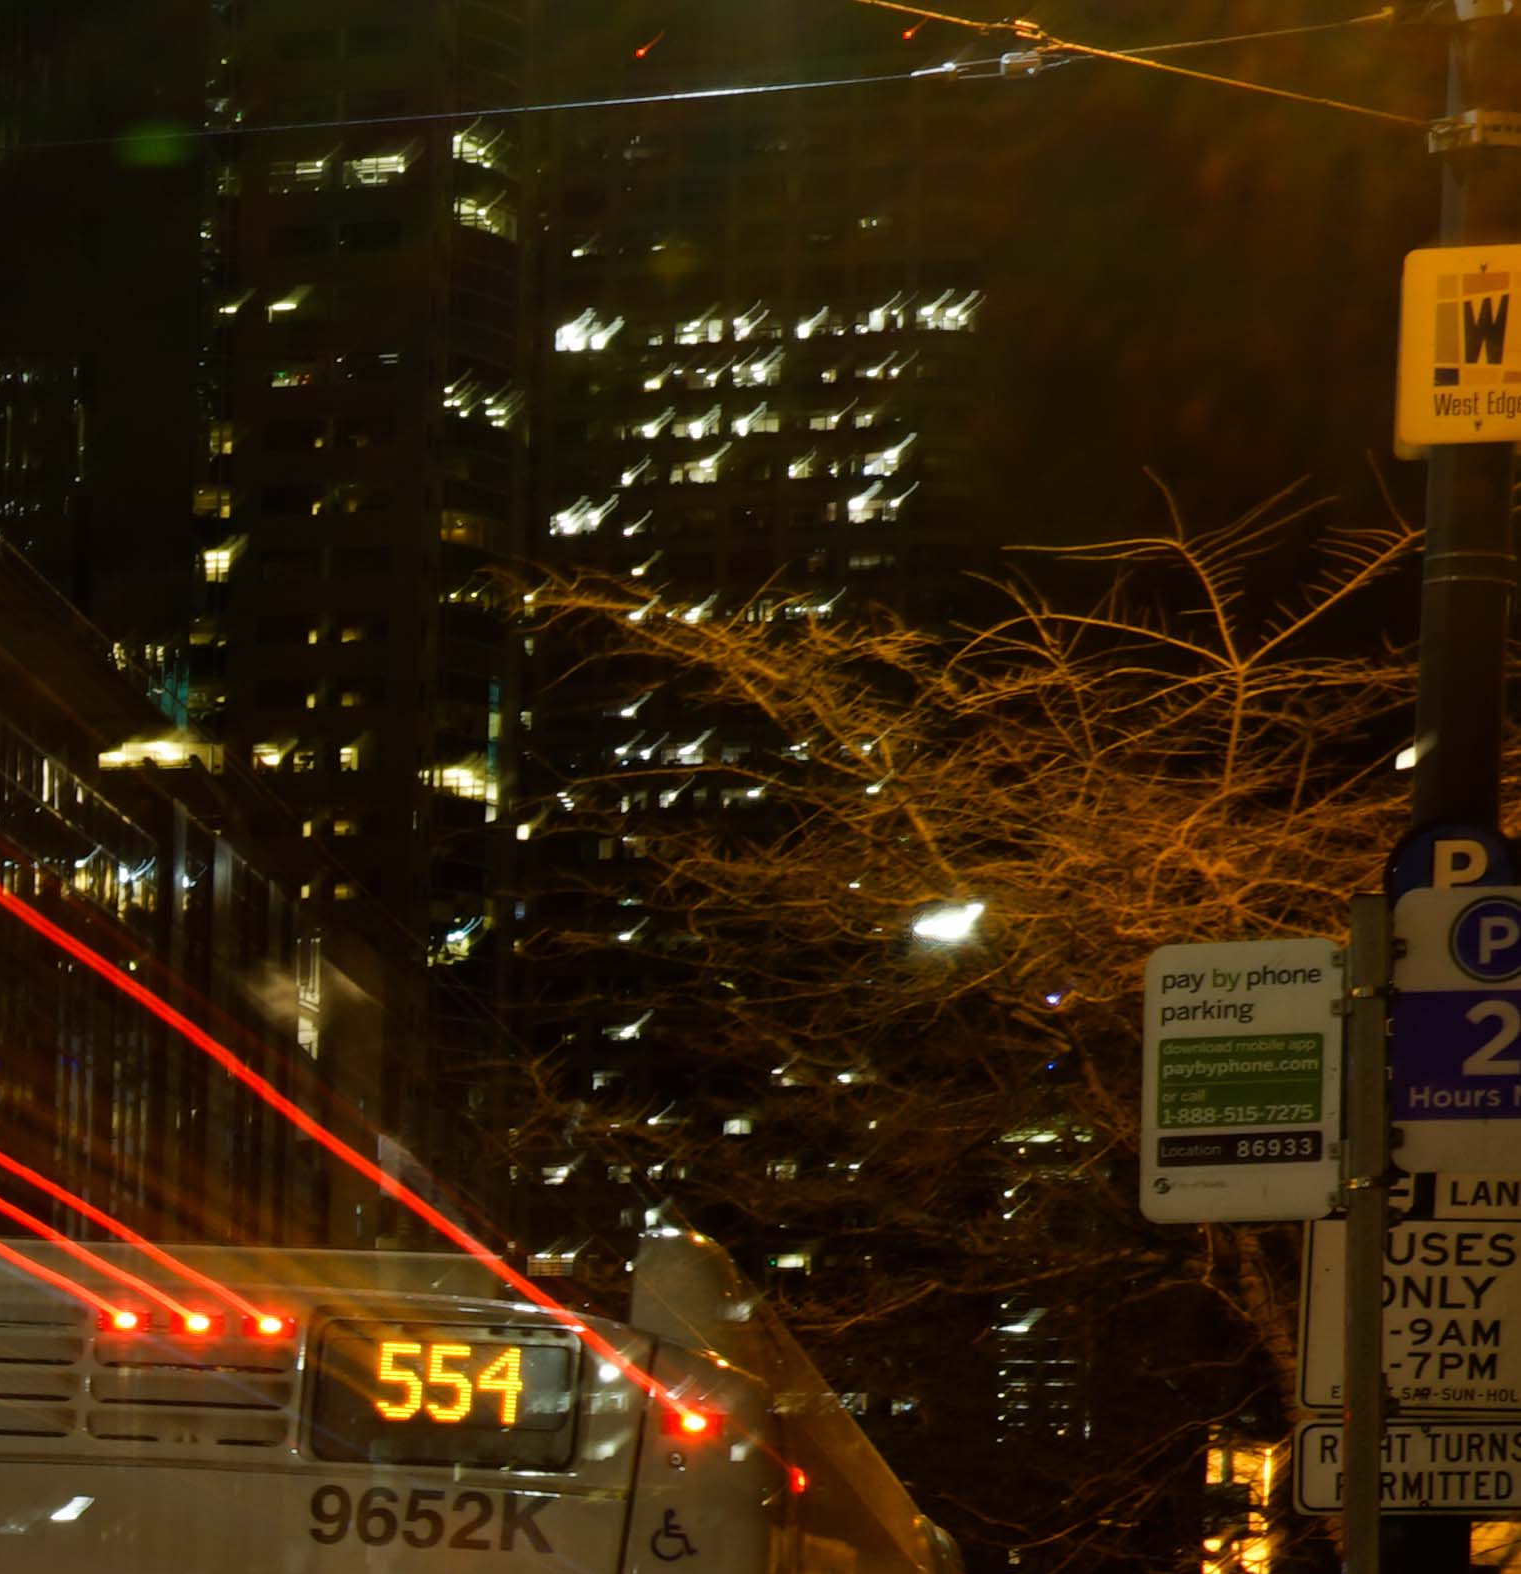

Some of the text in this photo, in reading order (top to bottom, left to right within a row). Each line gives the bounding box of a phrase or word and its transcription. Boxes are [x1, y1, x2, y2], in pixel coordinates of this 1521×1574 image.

[1463, 294, 1510, 365] W
[1434, 392, 1480, 417] West
[1433, 840, 1488, 888] P
[1478, 916, 1520, 965] P
[1161, 966, 1322, 994] pay by phone
[1161, 1000, 1254, 1025] parking
[1163, 1040, 1317, 1056] download mobile app
[1462, 1000, 1521, 1076] 2
[1163, 1058, 1318, 1079] paybyphone.com
[1162, 1089, 1206, 1103] or call
[1409, 1085, 1502, 1108] Hours
[1162, 1105, 1314, 1126] 1-888-515-7275
[1161, 1137, 1313, 1159] Location 86933
[1386, 1232, 1516, 1267] USES
[1390, 1318, 1501, 1347] -9AM
[1390, 1352, 1497, 1380] -7PM
[376, 1342, 524, 1425] 554
[1320, 1433, 1411, 1464] RHT
[1335, 1471, 1513, 1501] PRMITTED
[310, 1484, 555, 1553] 9652K
